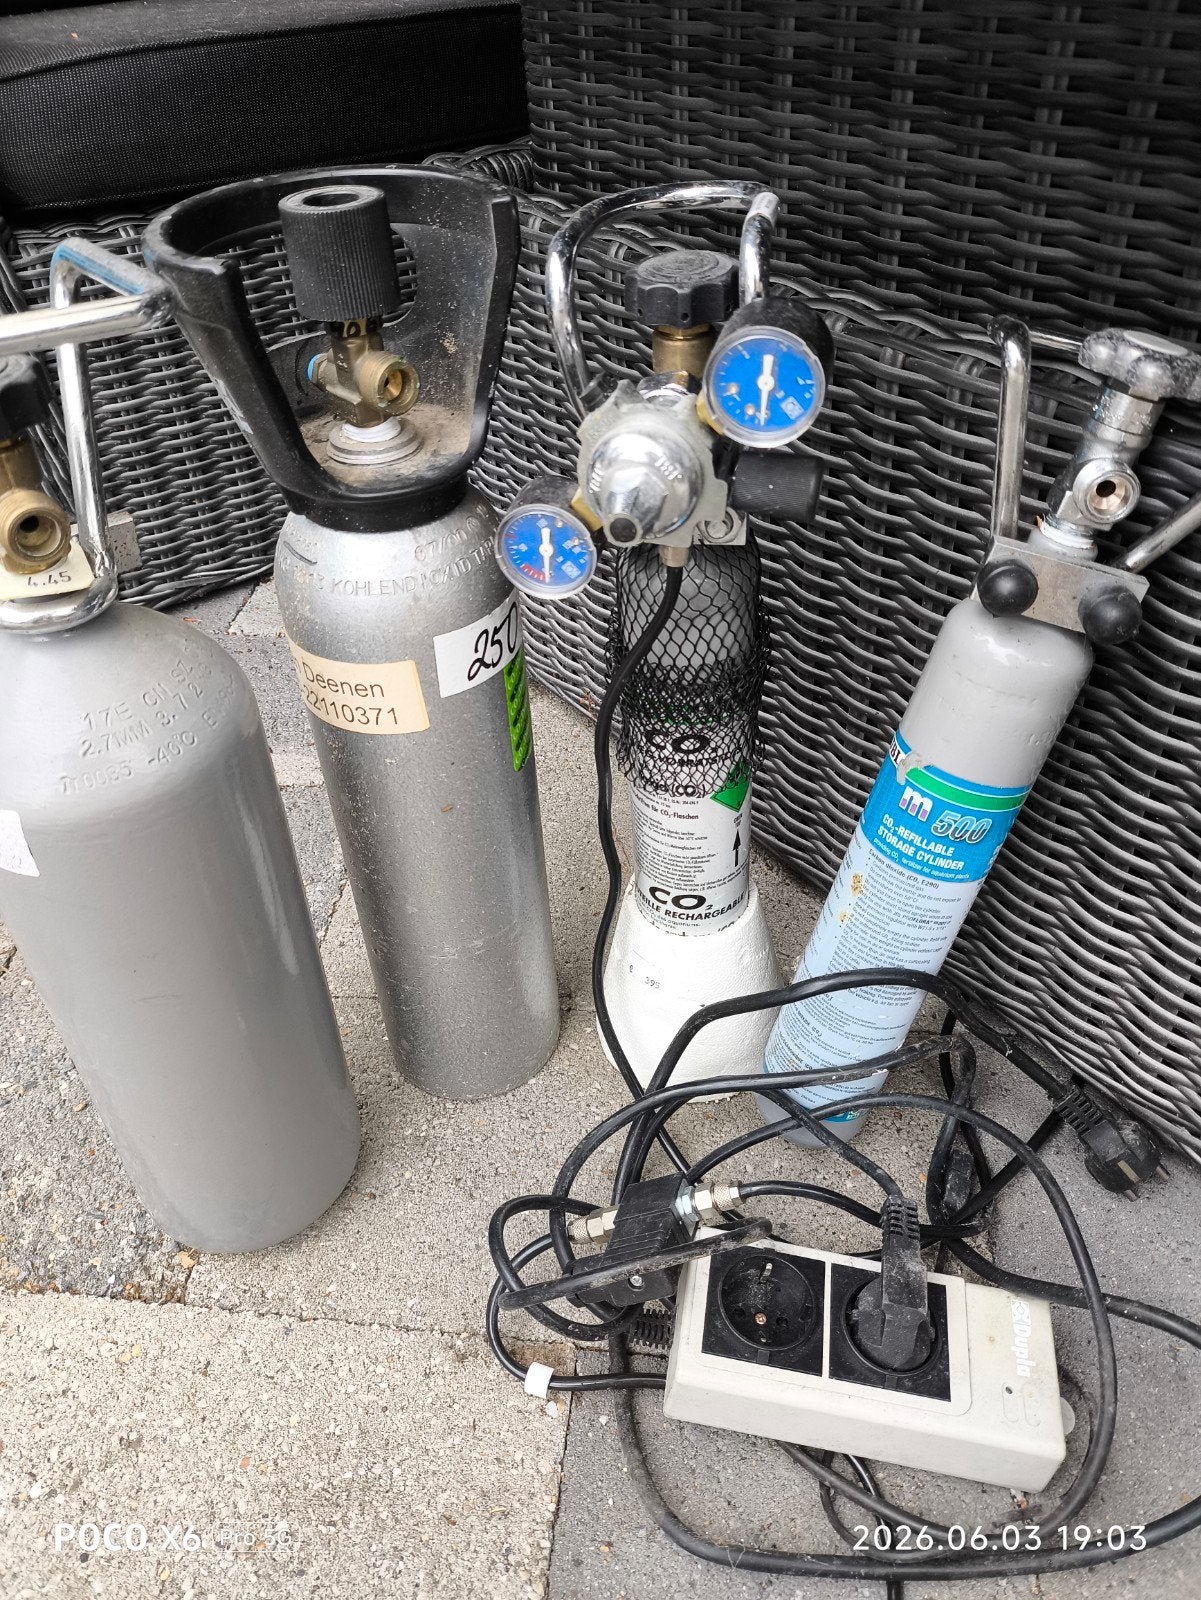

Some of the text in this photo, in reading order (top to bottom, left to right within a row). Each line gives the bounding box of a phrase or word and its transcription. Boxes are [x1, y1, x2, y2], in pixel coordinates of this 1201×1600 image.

[27, 571, 71, 587] 4.45
[467, 601, 518, 681] 250
[303, 662, 385, 698] Deenen
[882, 814, 955, 857] CO2-REFILLABLE
[931, 810, 993, 844] 500
[877, 825, 917, 857] STORAGE
[916, 850, 965, 871] CYLINDER
[637, 888, 661, 912] TEILLE
[664, 890, 745, 920] RECHARGEABLE
[648, 885, 713, 911] CO2
[1011, 1323, 1036, 1377] Dupla
